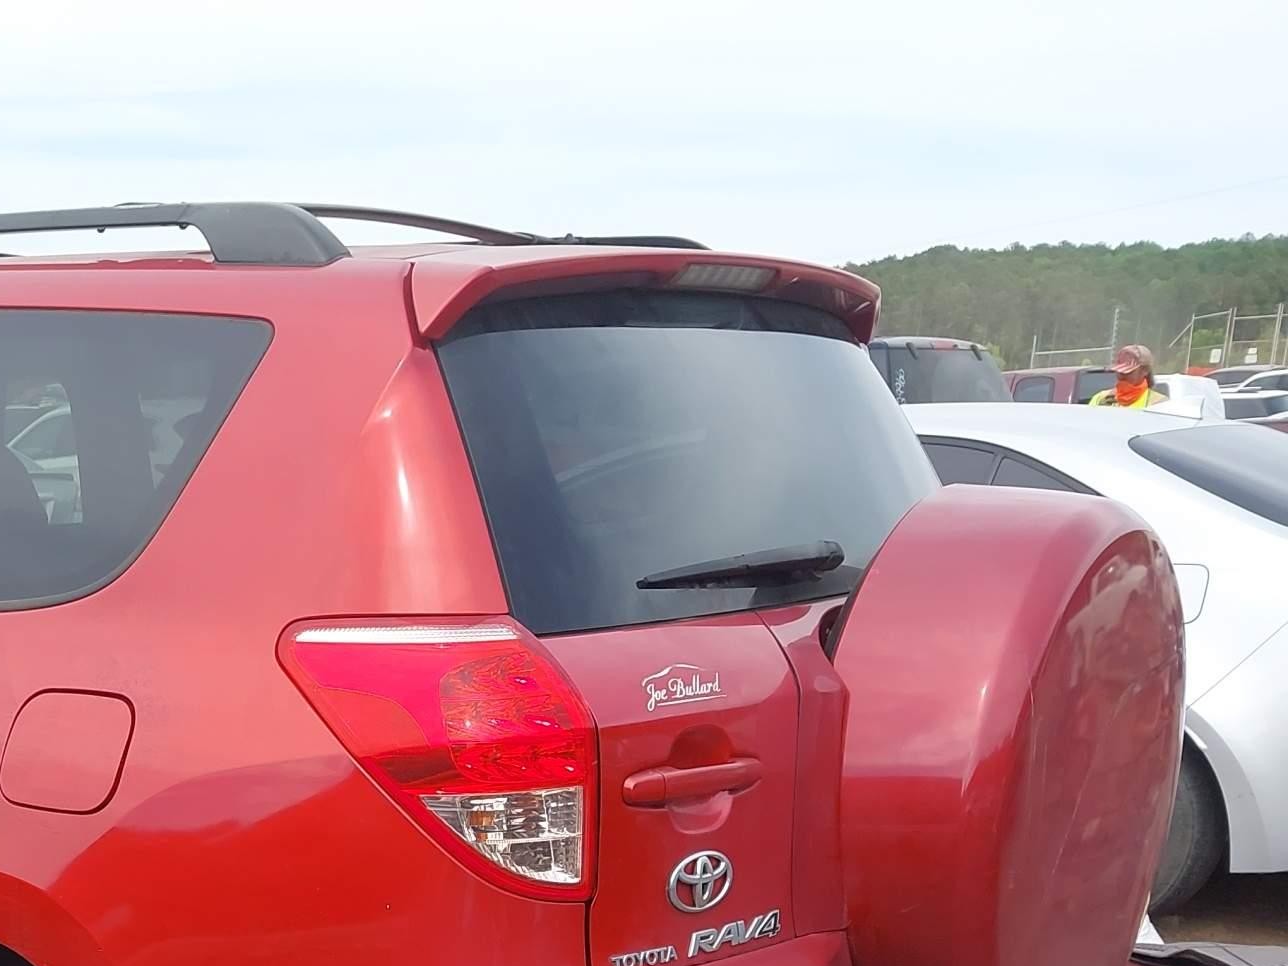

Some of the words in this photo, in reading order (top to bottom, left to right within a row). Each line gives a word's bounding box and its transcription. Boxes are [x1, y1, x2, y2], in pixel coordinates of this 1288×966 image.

[646, 683, 668, 712] Joe
[668, 671, 721, 698] Bullard
[687, 909, 781, 958] RAV4
